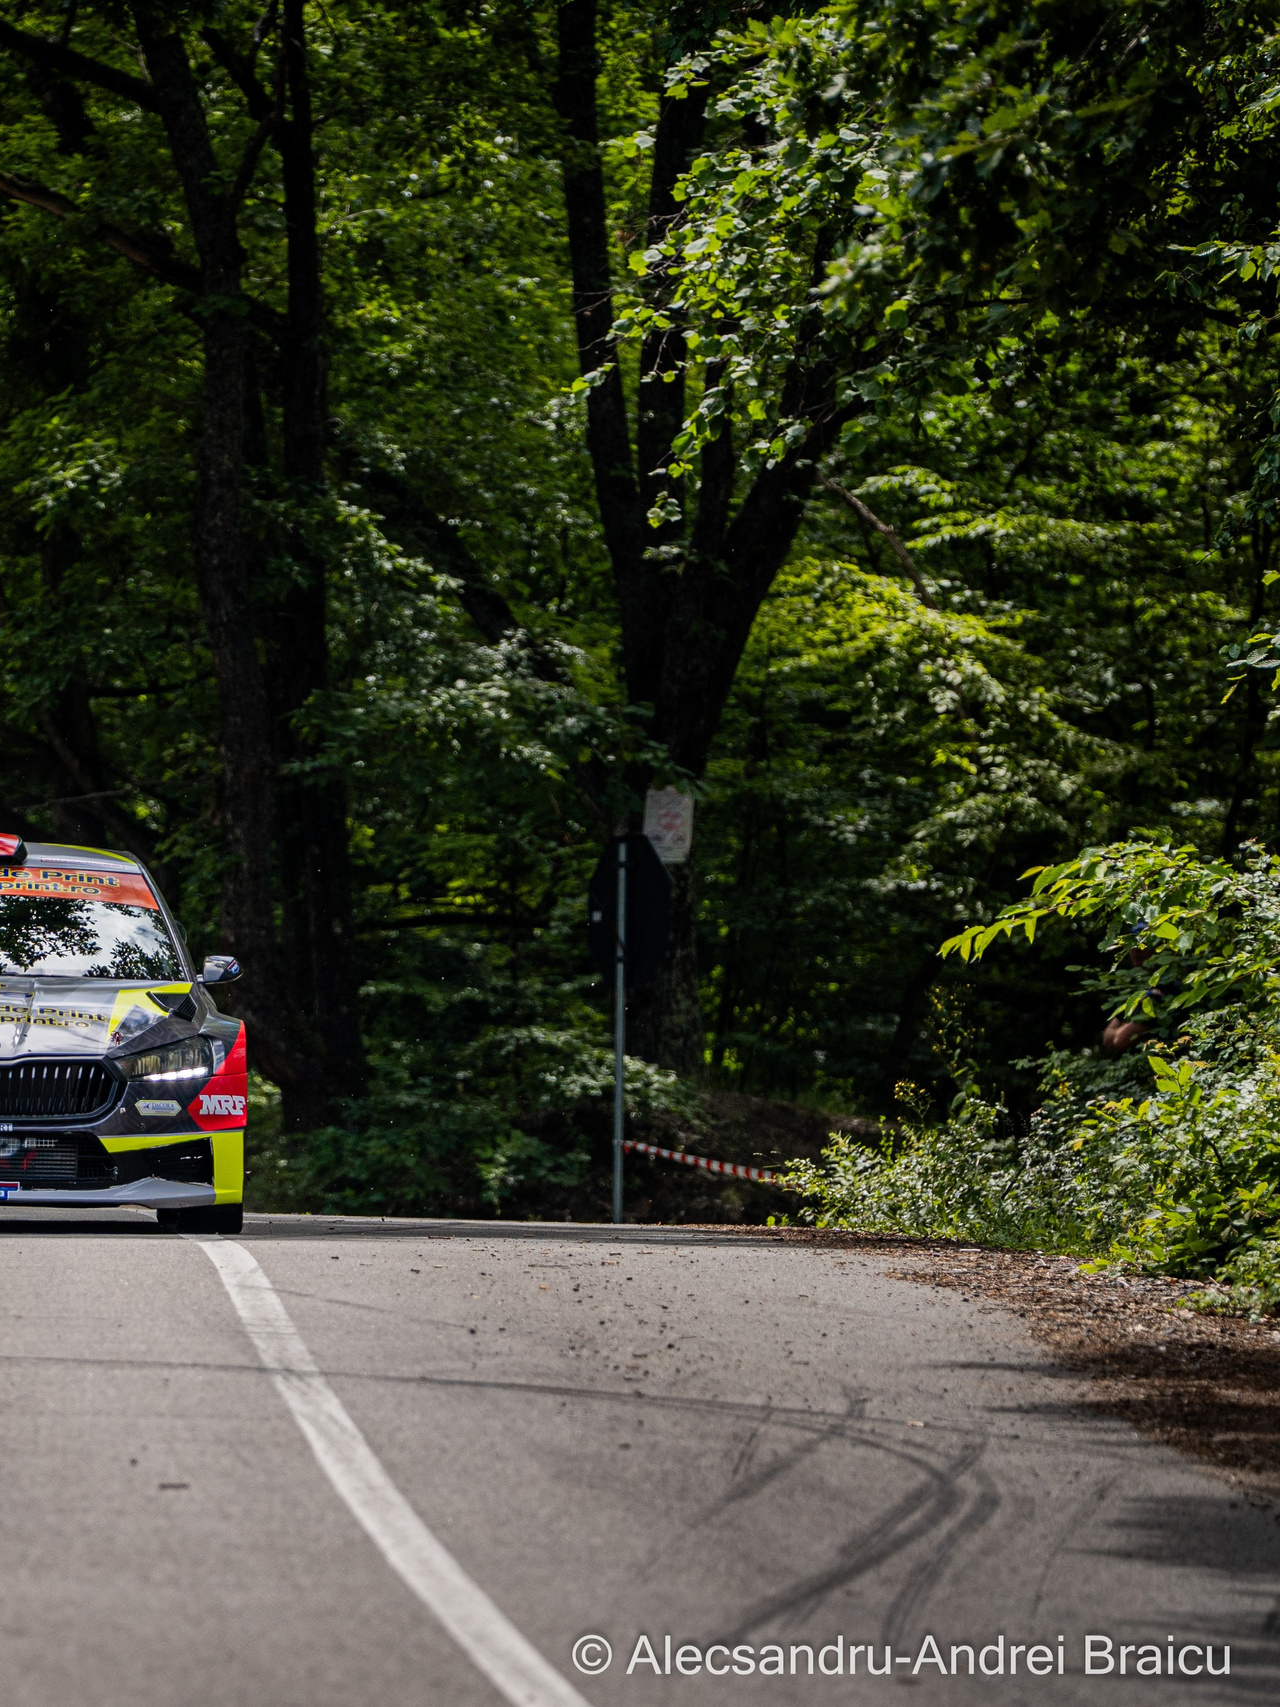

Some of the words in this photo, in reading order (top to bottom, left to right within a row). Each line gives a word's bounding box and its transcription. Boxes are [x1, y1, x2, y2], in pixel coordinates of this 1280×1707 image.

[41, 870, 120, 887] Print
[38, 1007, 107, 1022] Print
[199, 1094, 246, 1116] MRF
